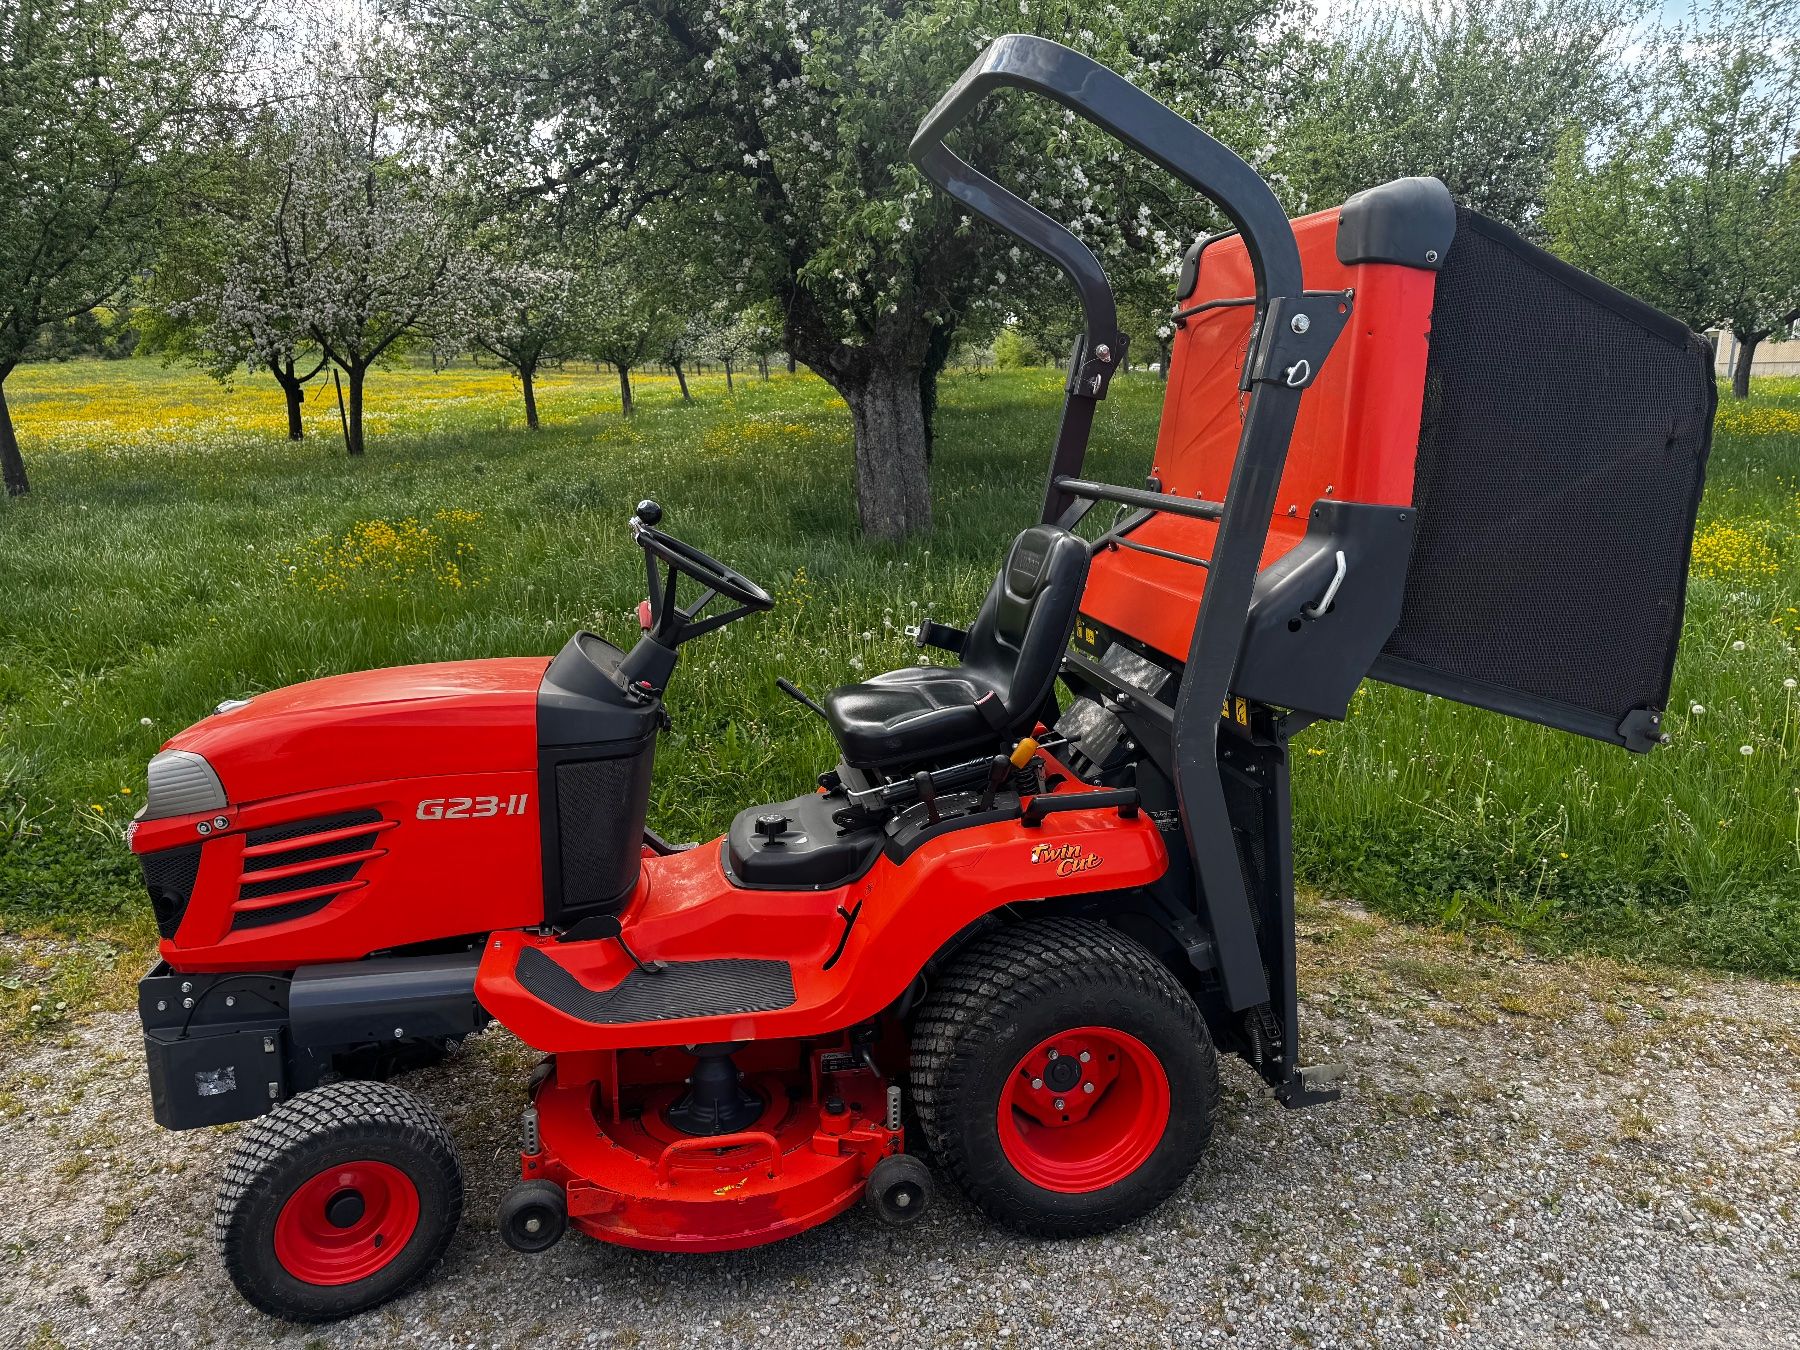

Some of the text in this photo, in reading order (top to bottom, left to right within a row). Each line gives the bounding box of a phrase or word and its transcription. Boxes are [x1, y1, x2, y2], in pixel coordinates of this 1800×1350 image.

[416, 794, 528, 820] G23-II
[1031, 843, 1081, 864] Twin
[1056, 853, 1103, 877] Cut
